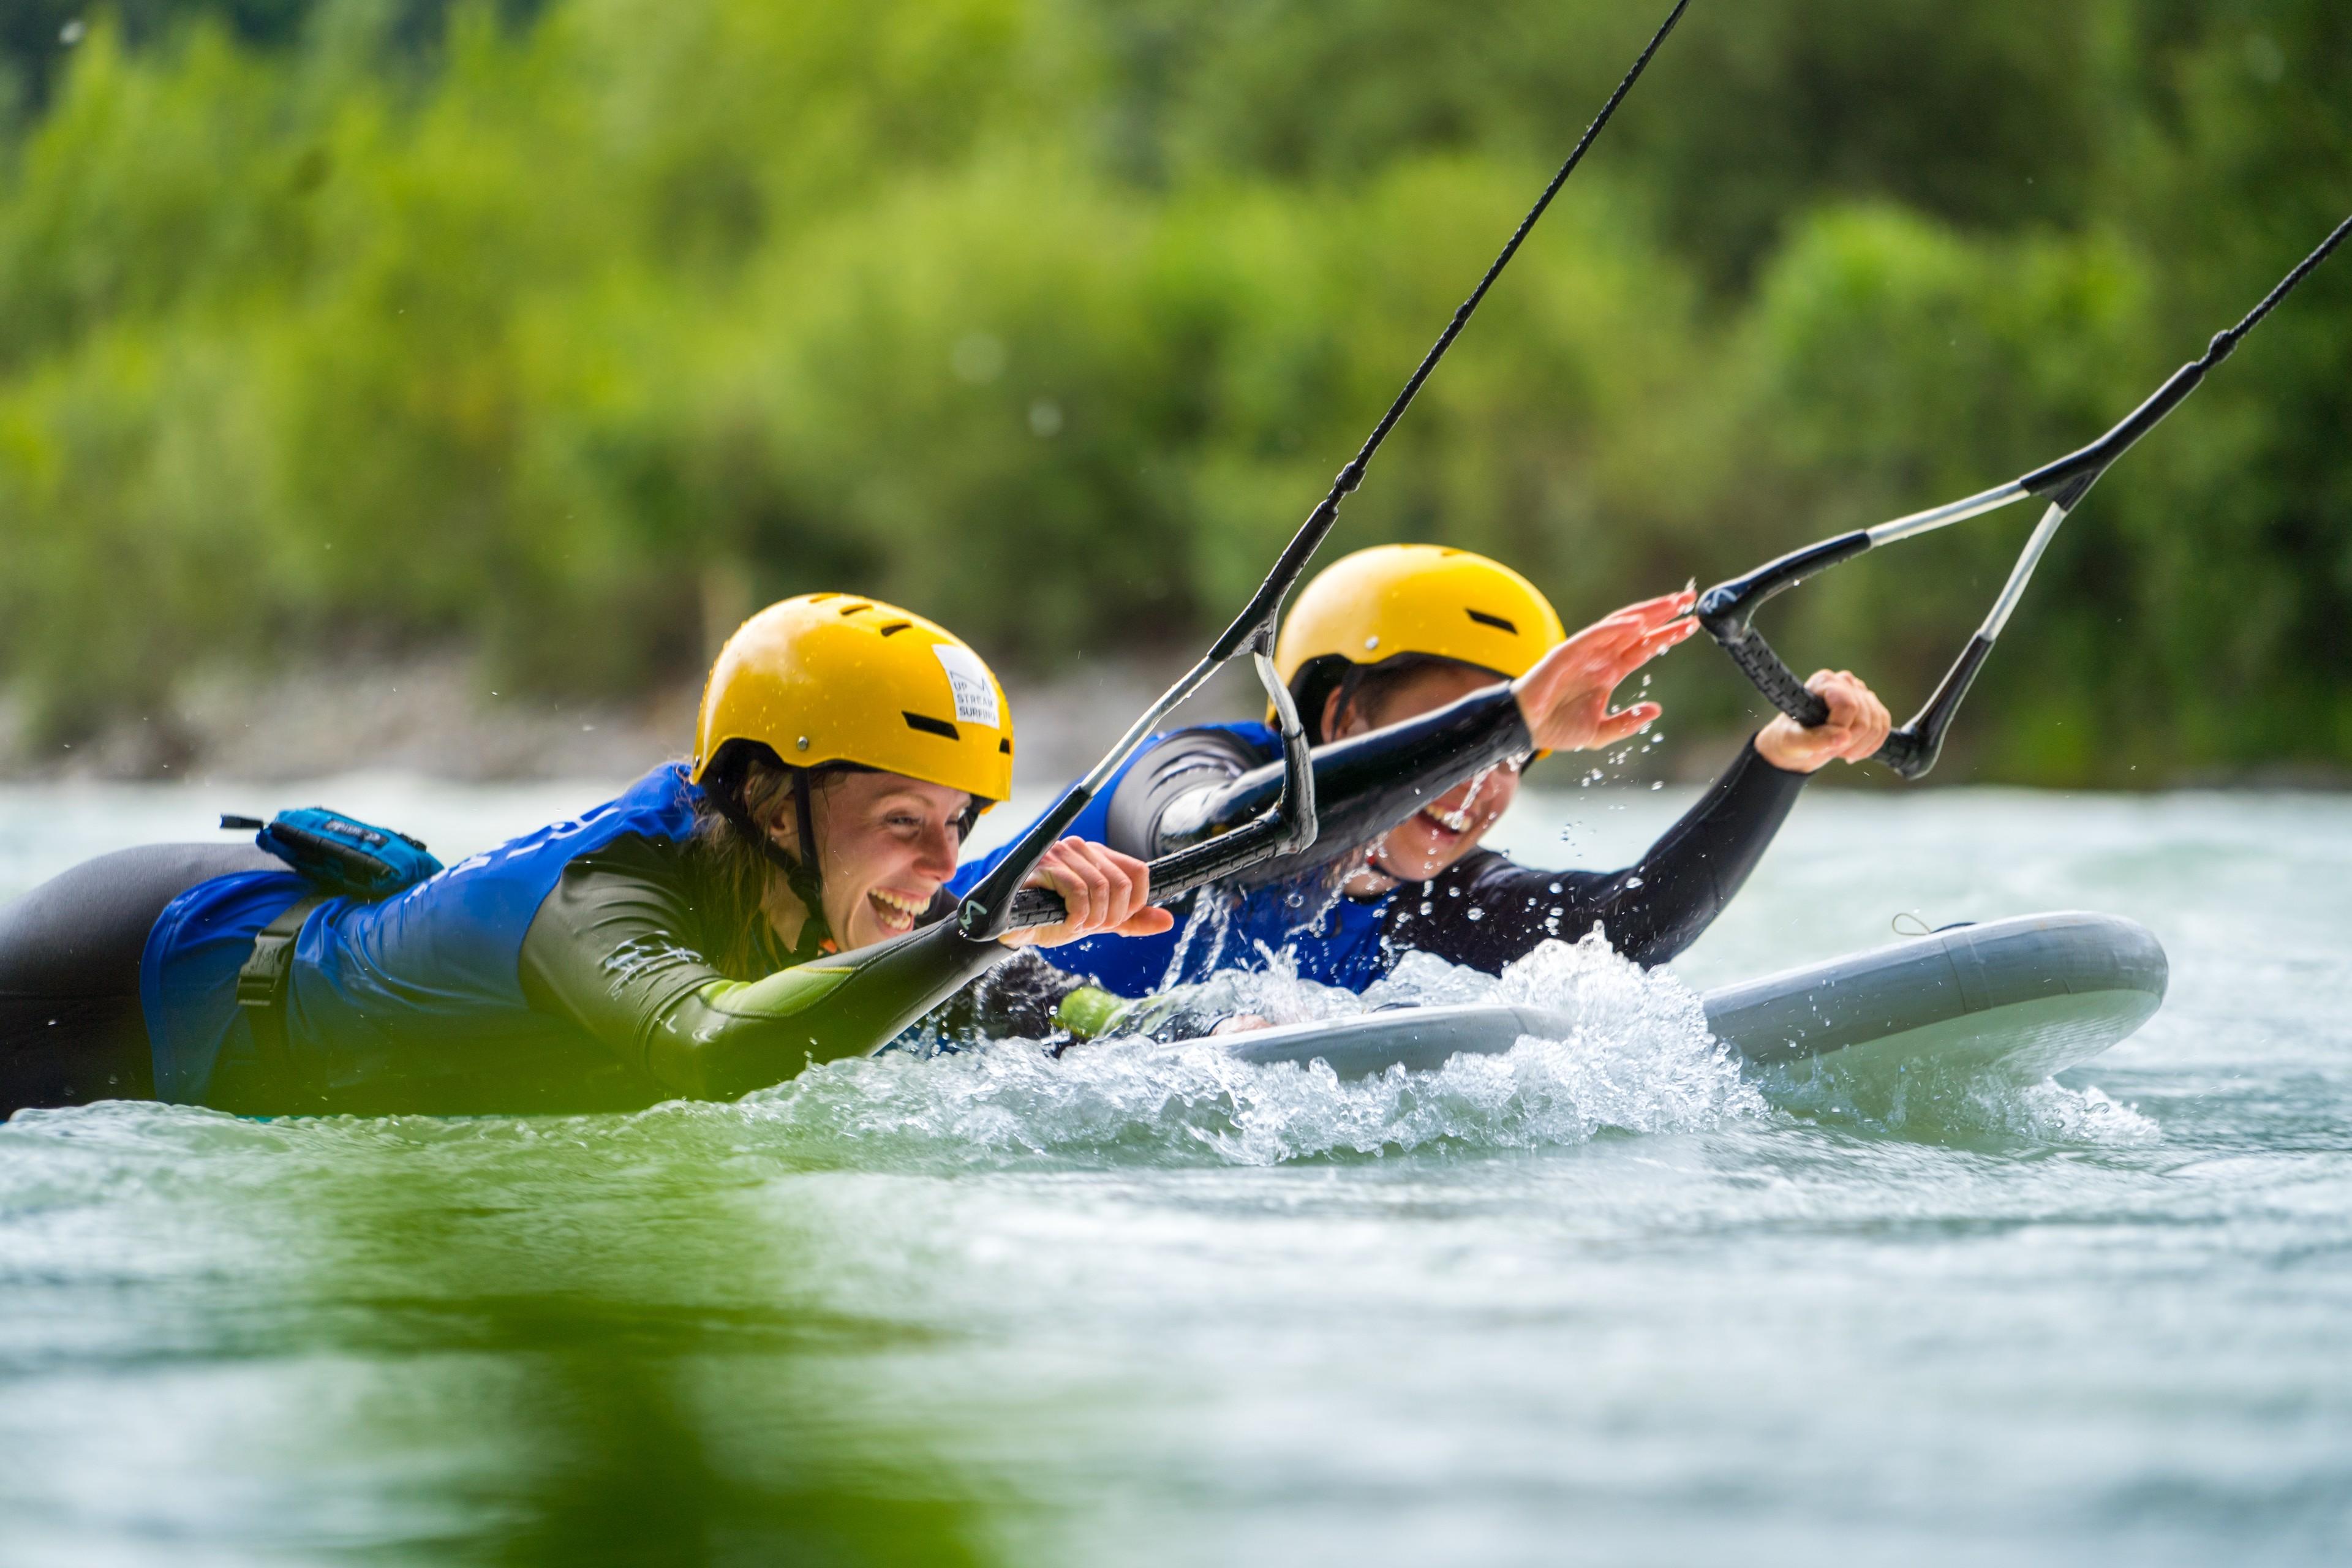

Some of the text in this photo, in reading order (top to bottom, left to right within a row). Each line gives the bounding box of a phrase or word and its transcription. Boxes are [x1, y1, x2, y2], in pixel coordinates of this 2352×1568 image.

[954, 682, 967, 691] UP
[957, 694, 993, 707] STREAM
[959, 706, 996, 722] SURFING
